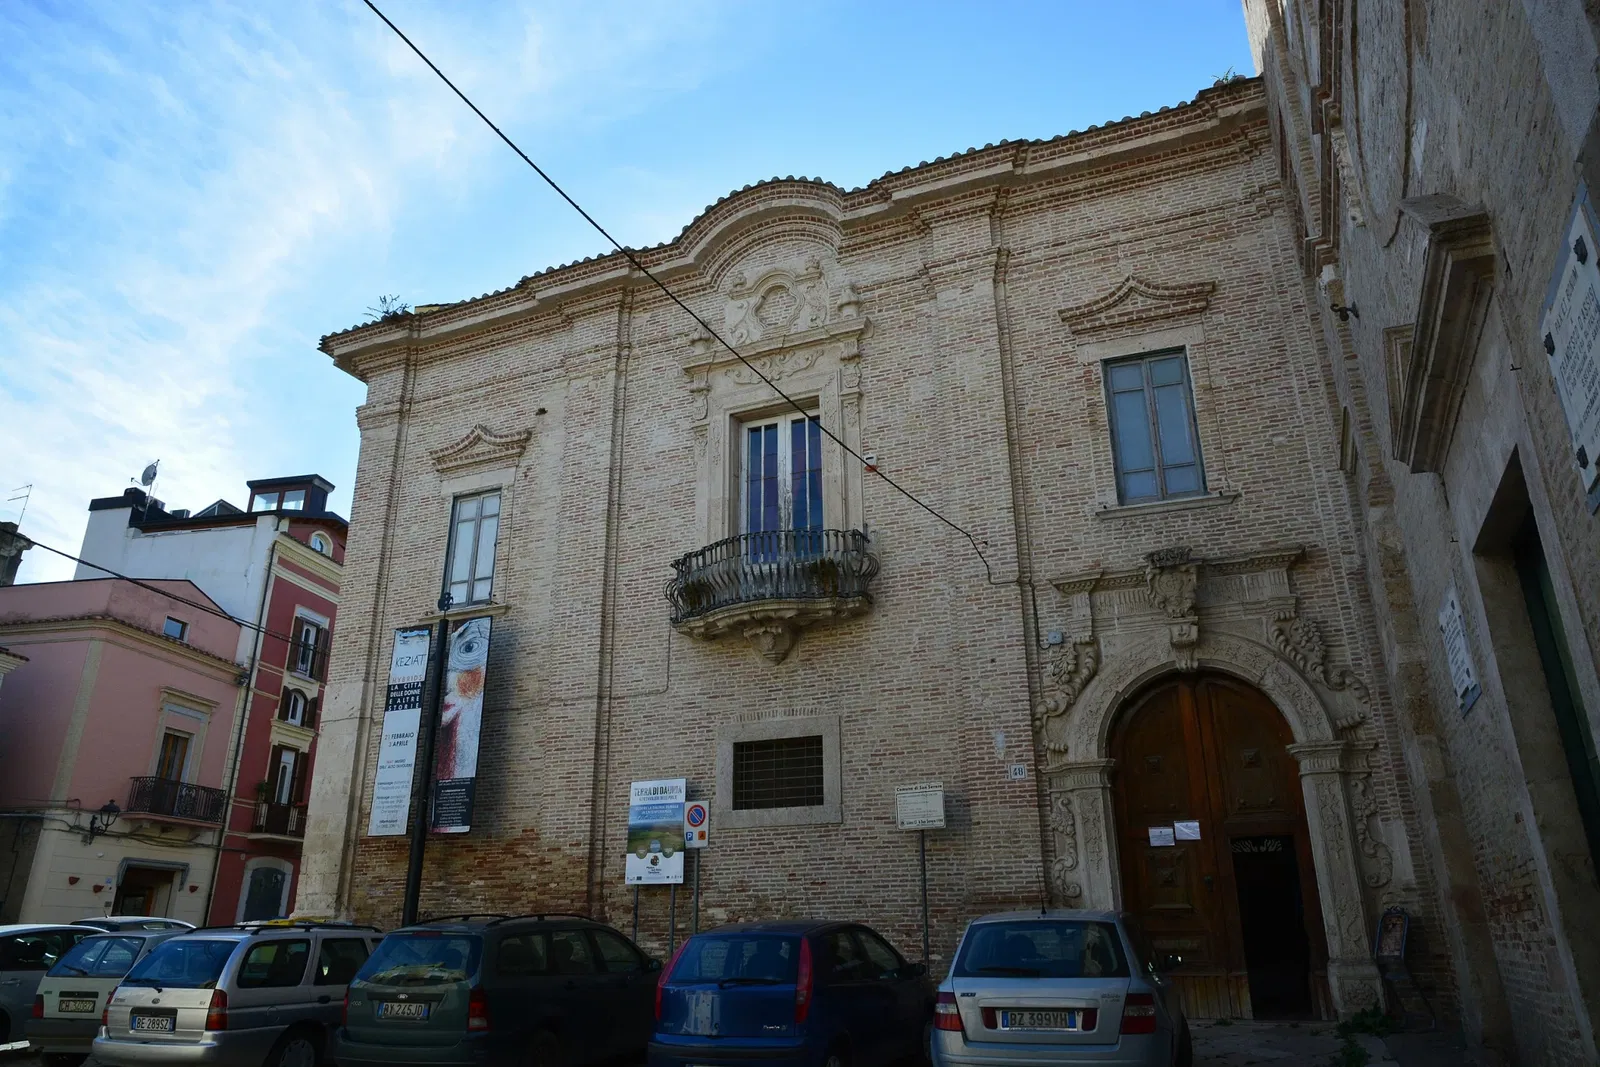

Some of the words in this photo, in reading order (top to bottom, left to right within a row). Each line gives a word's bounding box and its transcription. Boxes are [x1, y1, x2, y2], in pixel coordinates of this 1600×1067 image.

[396, 654, 426, 667] KEZIAT
[388, 702, 419, 711] STORIE
[1010, 1013, 1024, 1026] BZ
[1029, 1013, 1067, 1027] 399VH
